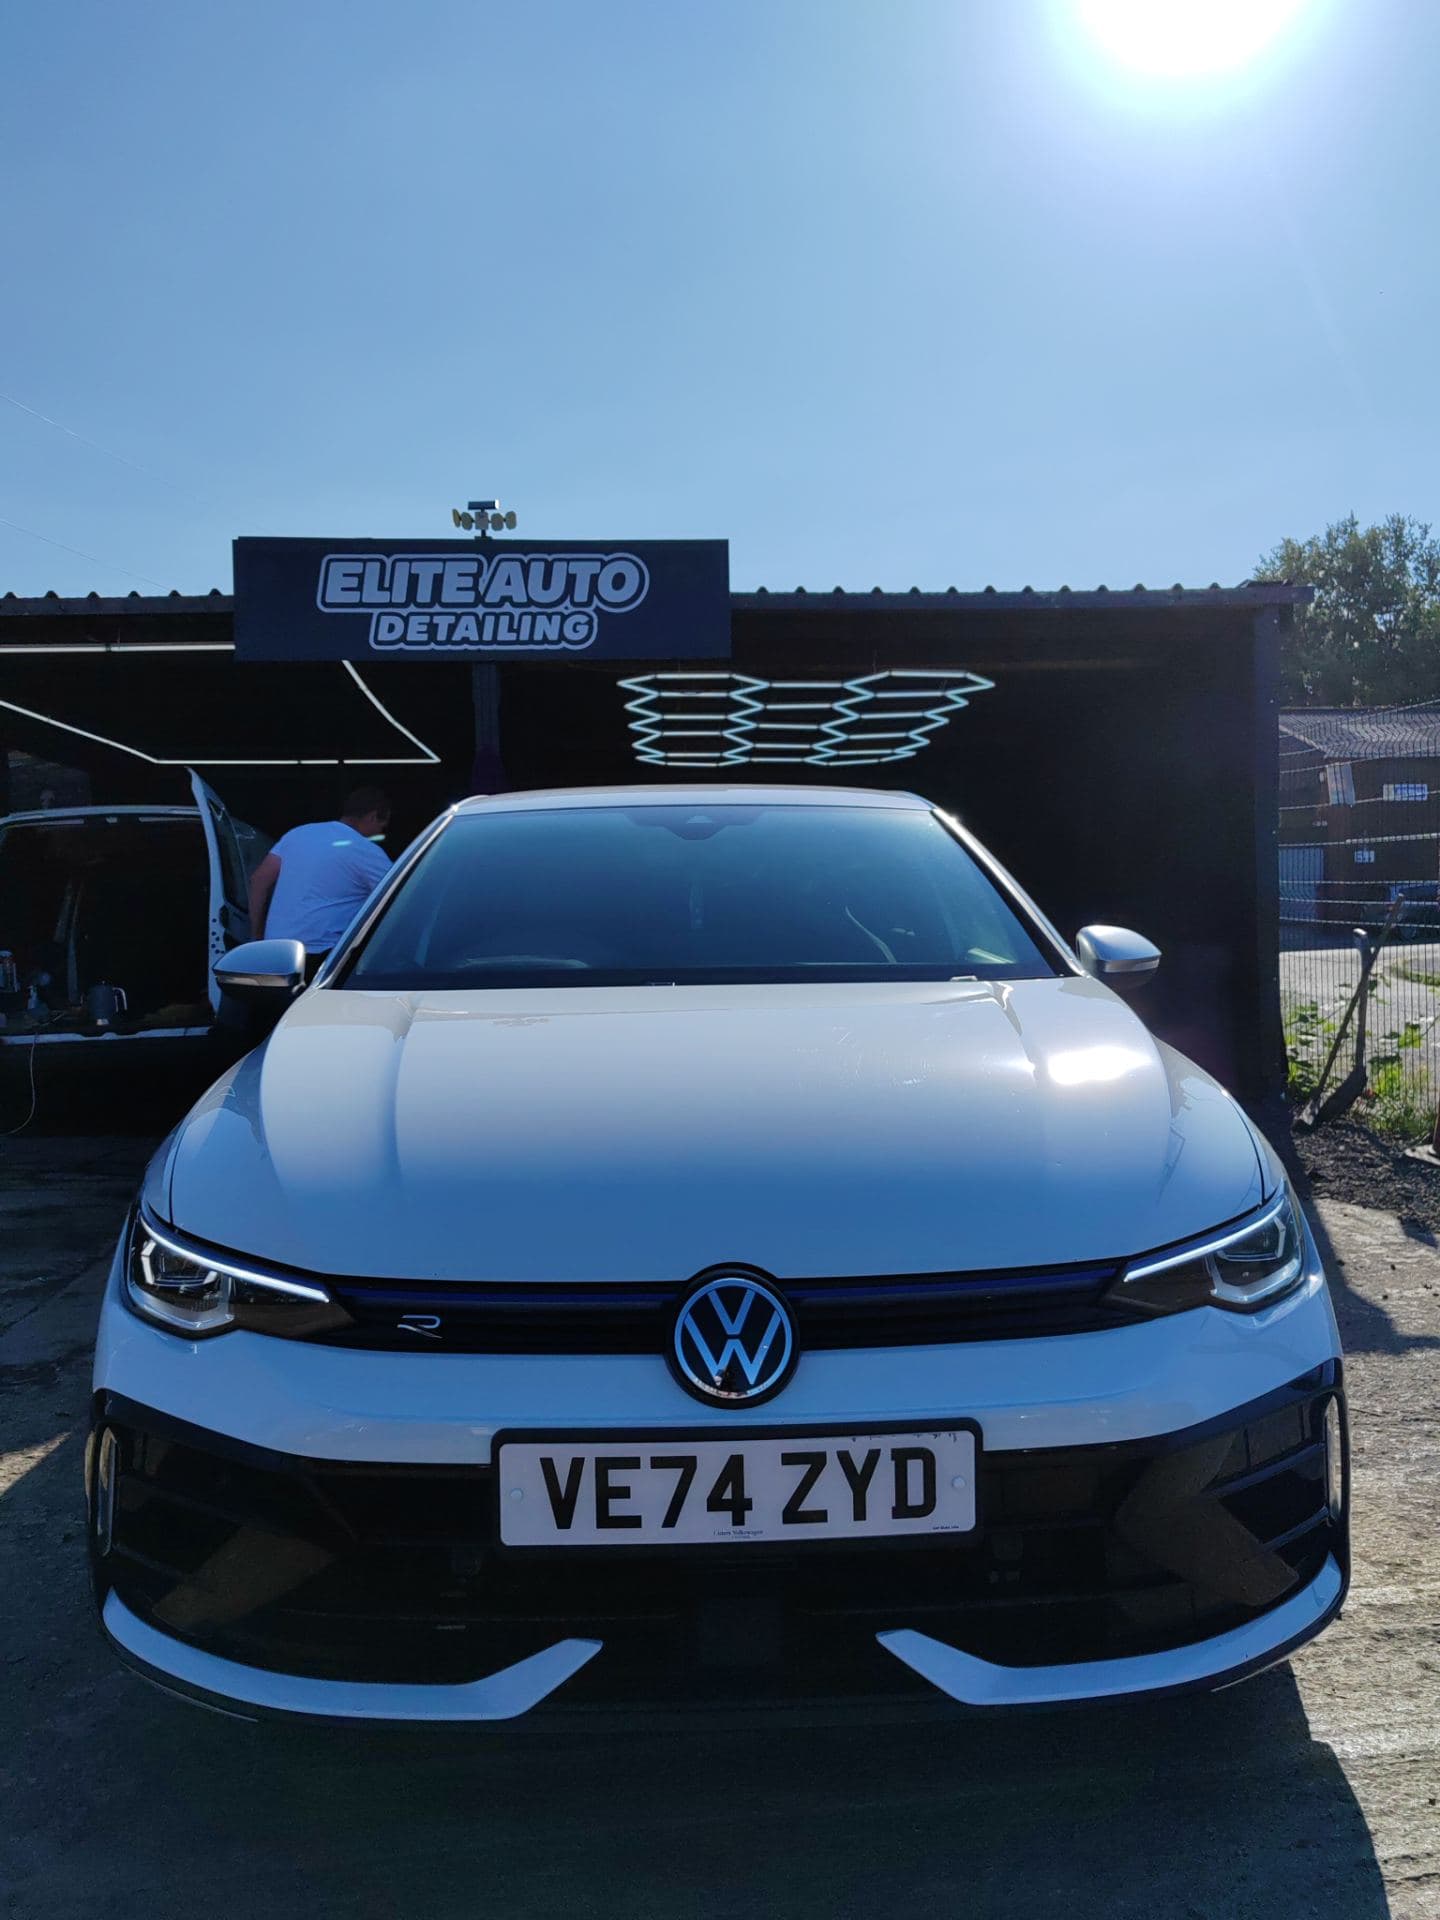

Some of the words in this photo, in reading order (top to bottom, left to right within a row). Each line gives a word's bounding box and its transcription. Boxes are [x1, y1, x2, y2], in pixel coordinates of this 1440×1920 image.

[323, 560, 479, 603] ELITE
[482, 558, 641, 604] AUTO
[376, 614, 592, 642] DETAILING
[539, 1454, 753, 1530] VE74
[780, 1446, 937, 1525] ZYD
